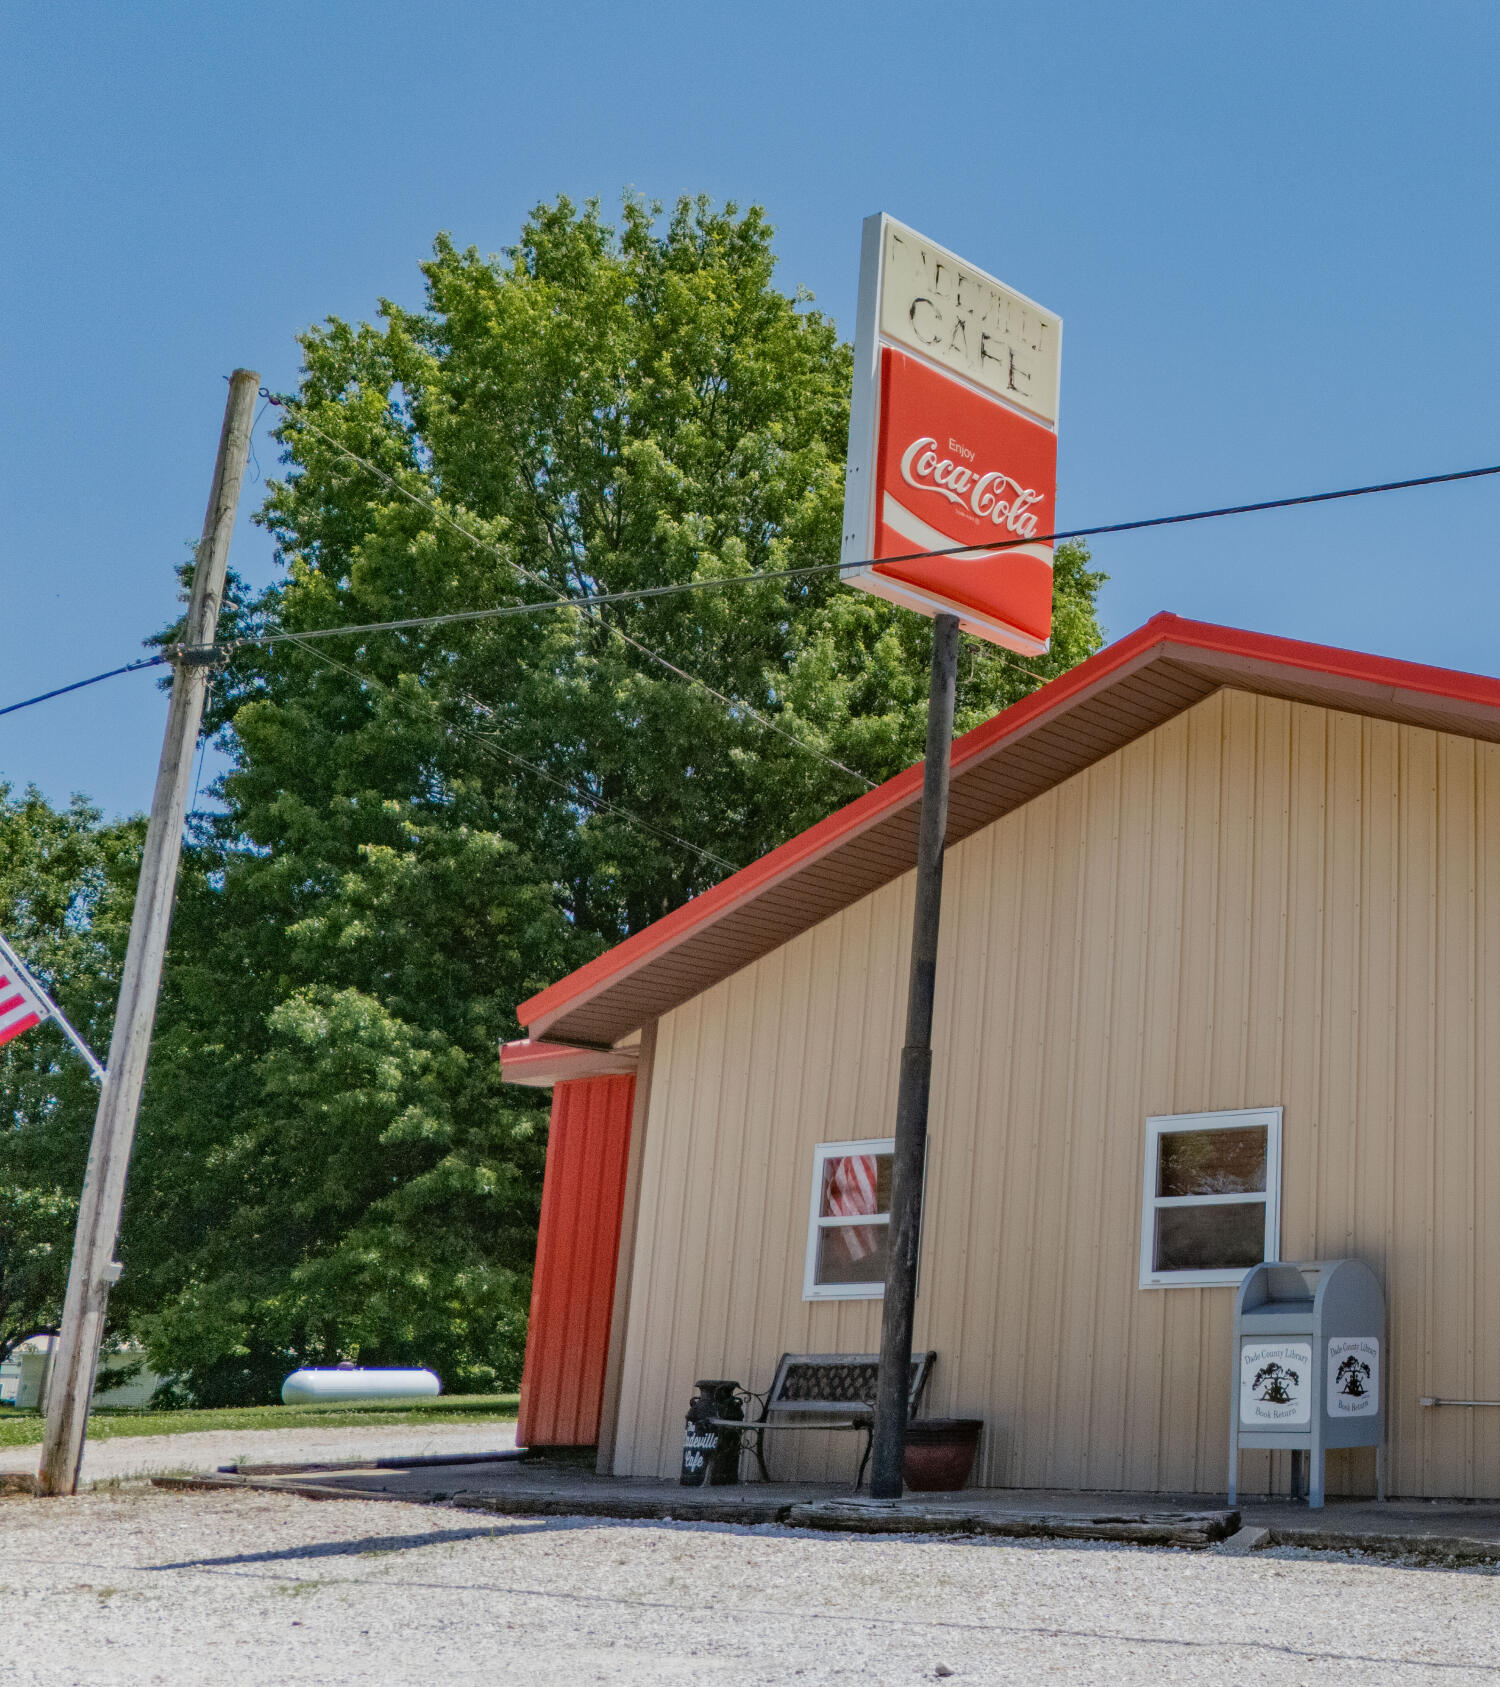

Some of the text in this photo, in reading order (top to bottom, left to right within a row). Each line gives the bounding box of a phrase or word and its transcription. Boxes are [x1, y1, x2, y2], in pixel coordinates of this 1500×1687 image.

[909, 297, 1034, 397] CAFE
[948, 437, 976, 463] Enjoy
[901, 437, 1045, 539] Coca-Cola
[1245, 1347, 1308, 1365] Dade County Library
[1255, 1406, 1297, 1419] Book Return
